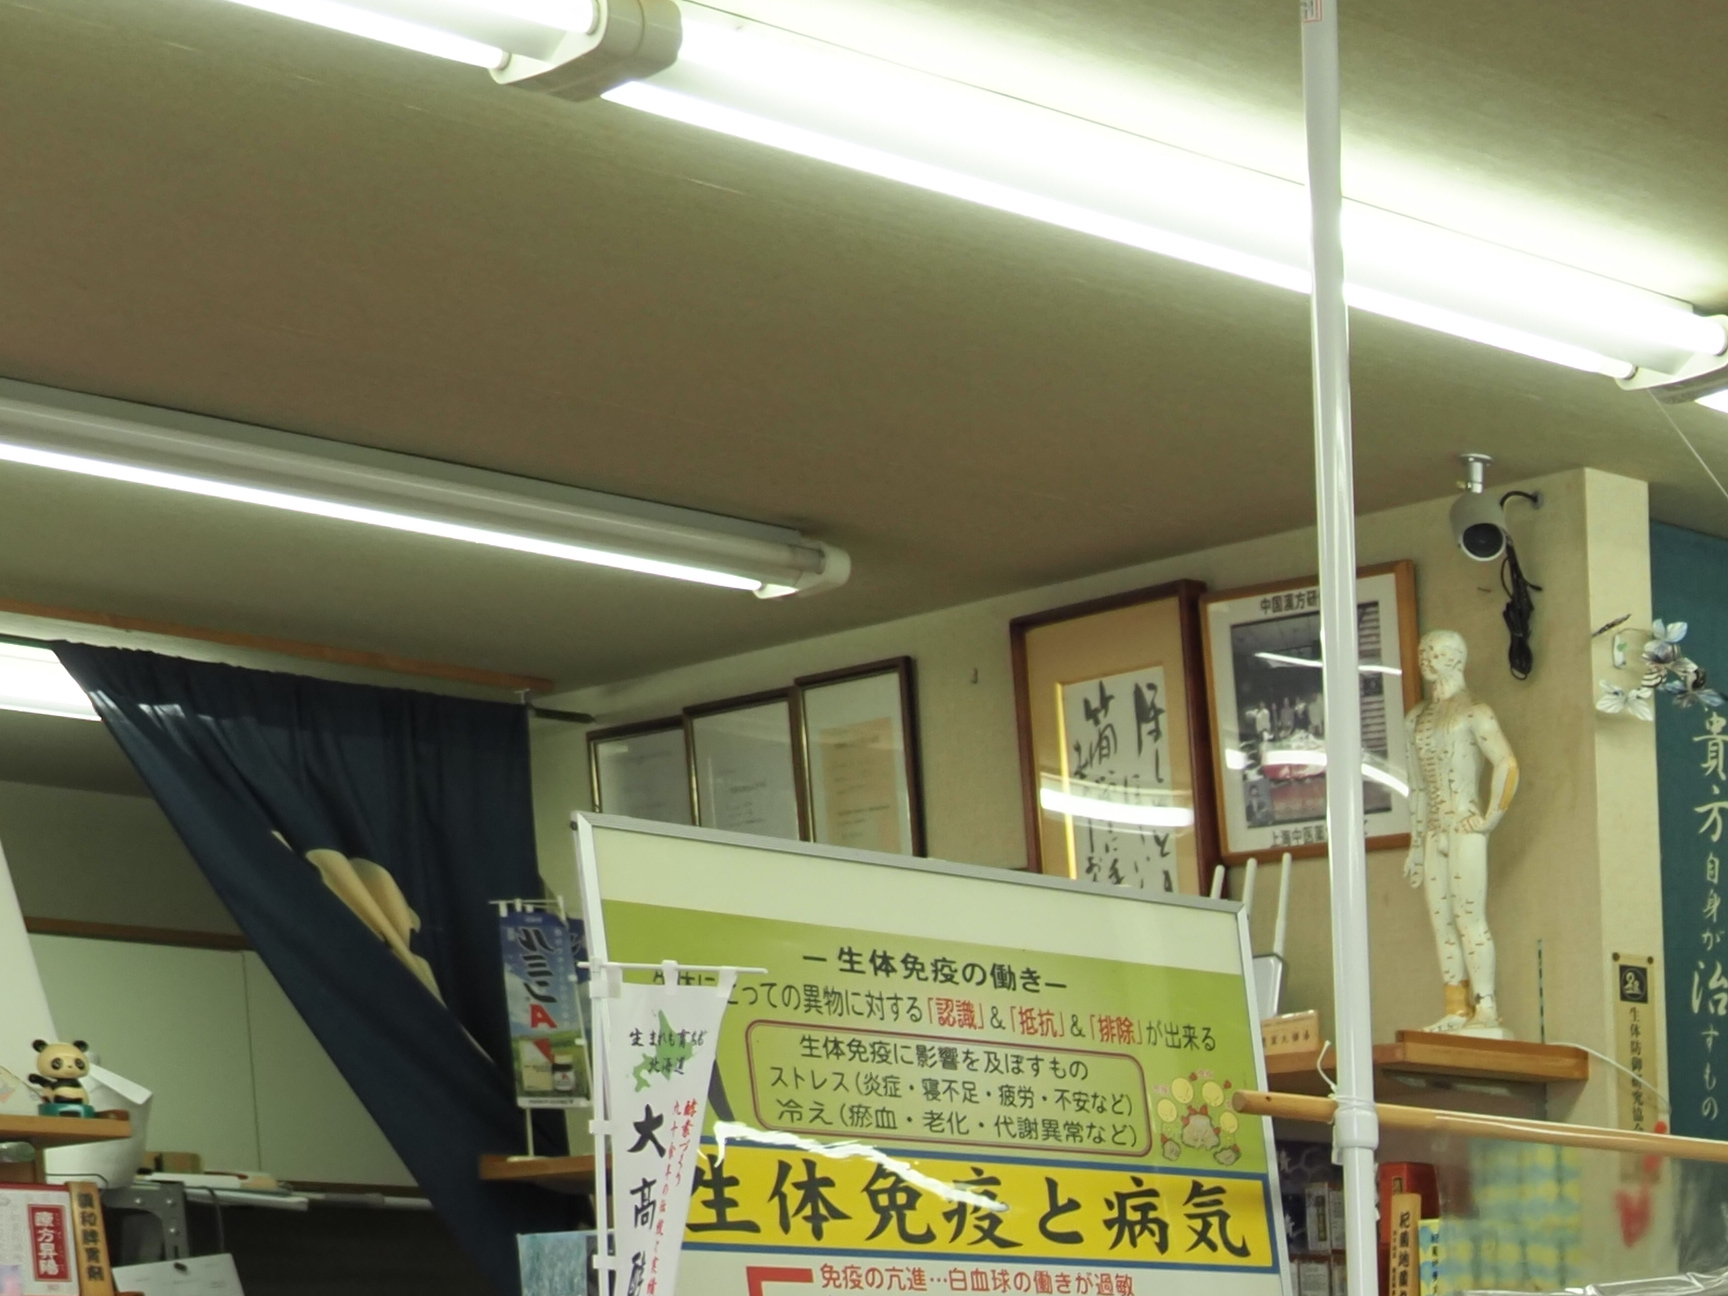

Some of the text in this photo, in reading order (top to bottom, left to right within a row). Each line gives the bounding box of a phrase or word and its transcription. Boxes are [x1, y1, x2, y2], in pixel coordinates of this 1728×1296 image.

[647, 1056, 686, 1076] 北海道
[798, 1034, 1090, 1082] 生体免疫に影響を及ぼすもの
[688, 1156, 1256, 1259] 生体免疫と病気
